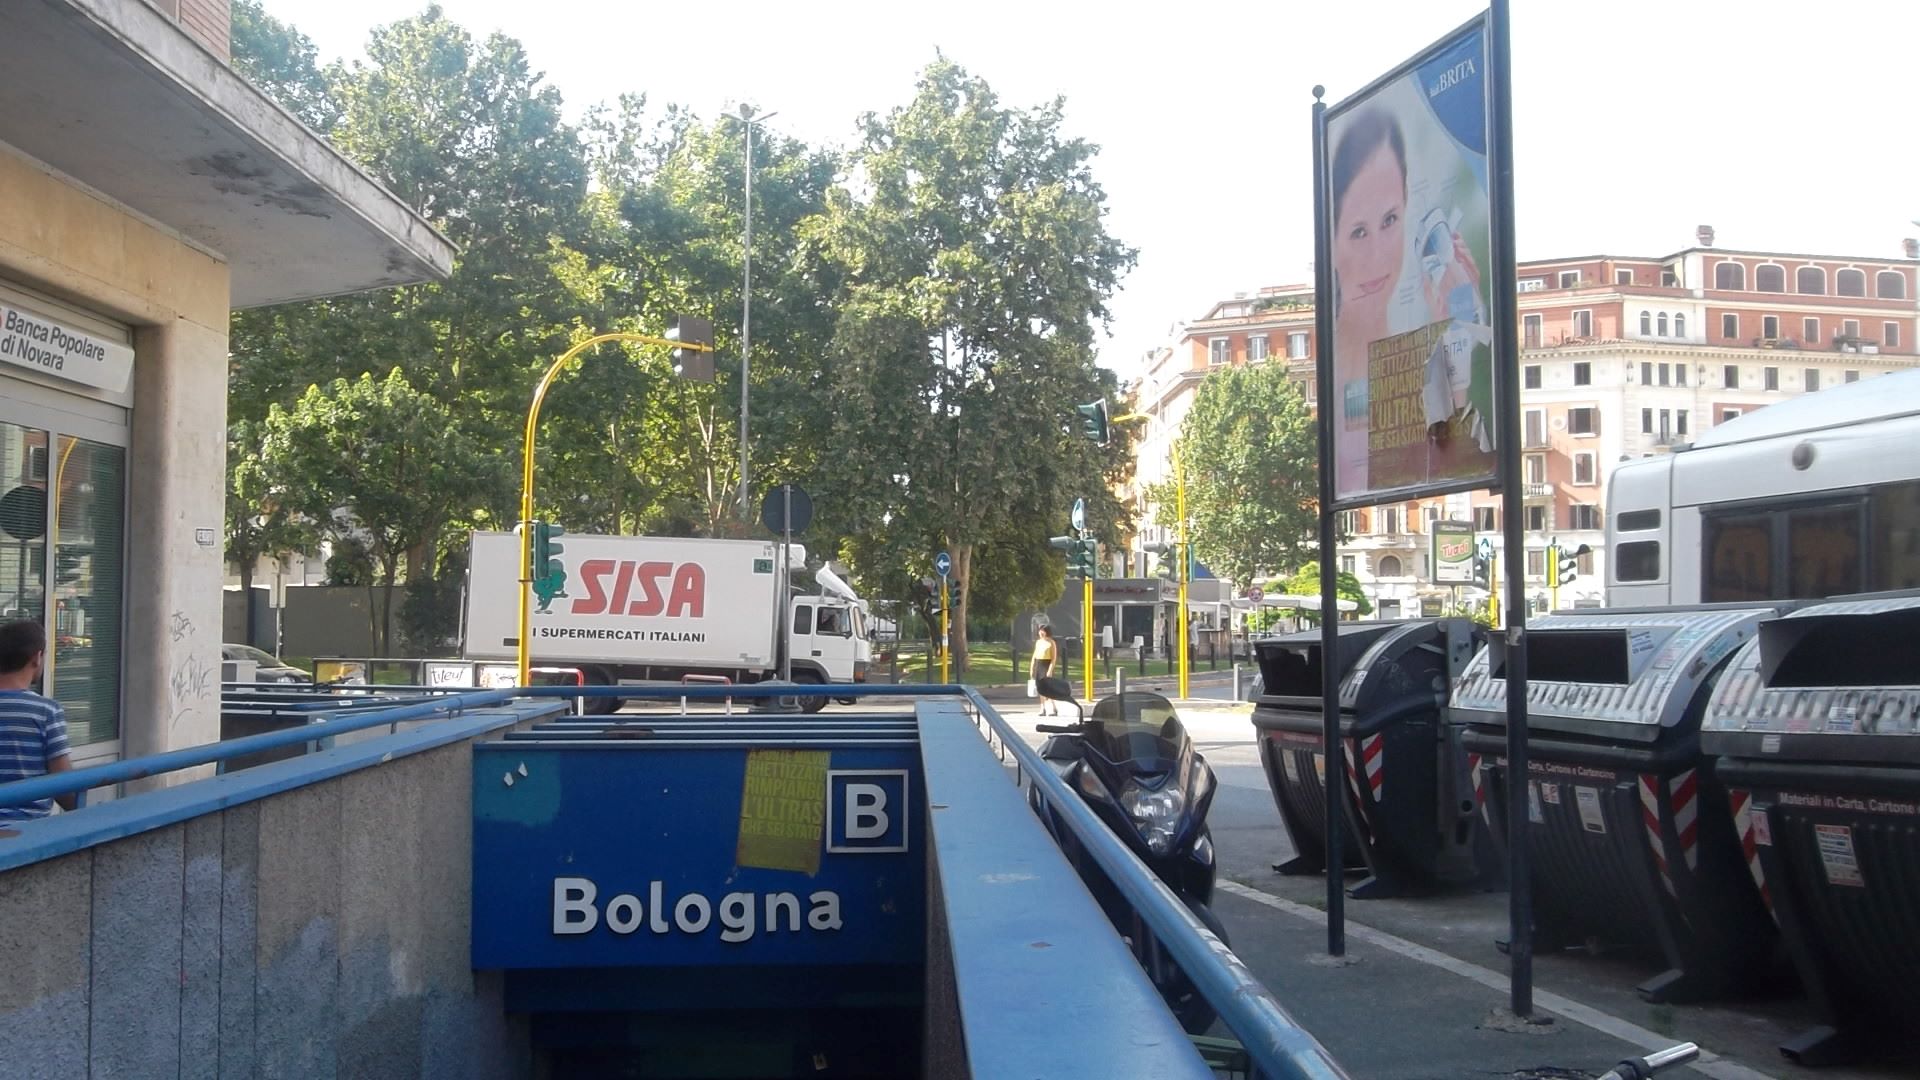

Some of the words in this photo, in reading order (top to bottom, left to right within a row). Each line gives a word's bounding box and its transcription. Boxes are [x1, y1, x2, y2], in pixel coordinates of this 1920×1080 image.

[1440, 58, 1475, 91] BRITA
[5, 310, 48, 342] Banca
[50, 326, 105, 361] Popolare
[1, 335, 16, 355] di
[17, 338, 64, 371] Novara
[571, 559, 706, 618] SISA
[532, 627, 537, 637] I
[541, 628, 645, 641] SUPERMERCATI
[650, 631, 705, 643] ITALIANI
[746, 776, 826, 800] RIMPIANGO
[1780, 792, 1822, 806] Materiali
[1823, 797, 1834, 807] in
[1869, 799, 1915, 815] Cartone
[742, 795, 824, 825] L'ULTRAS
[845, 783, 889, 839] B
[741, 819, 766, 834] CHE
[768, 821, 784, 836] SEI
[786, 823, 823, 841] STATO
[553, 877, 843, 943] Bologna
